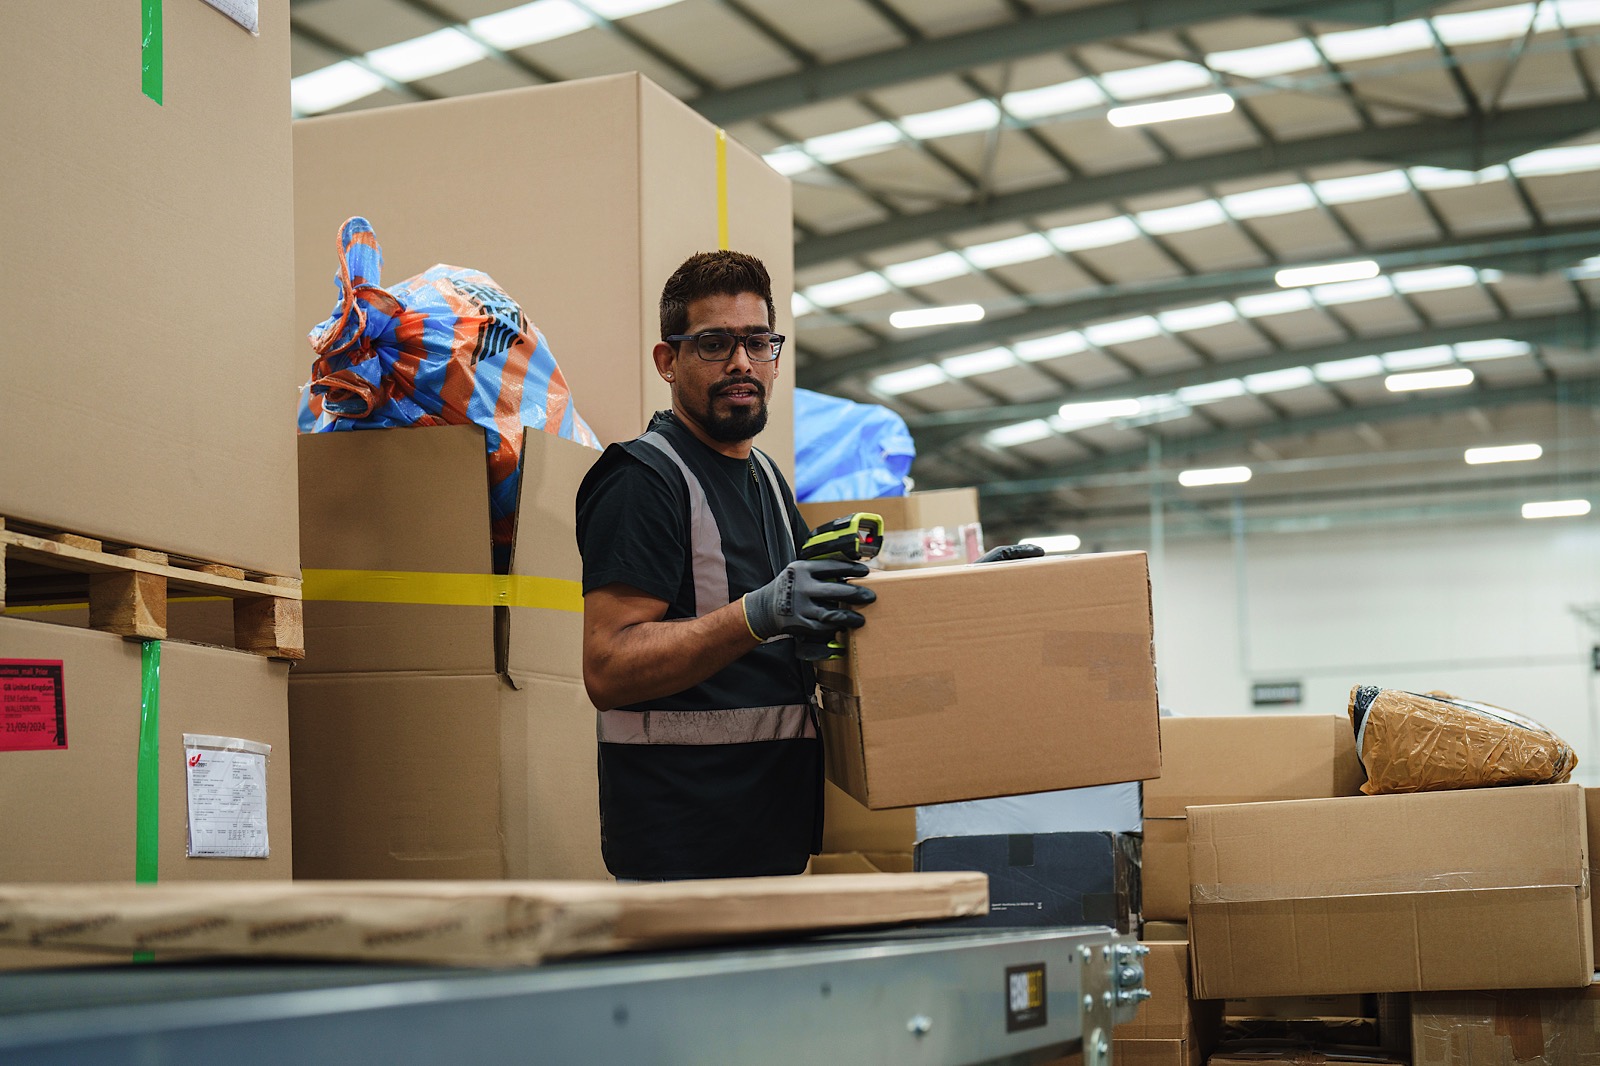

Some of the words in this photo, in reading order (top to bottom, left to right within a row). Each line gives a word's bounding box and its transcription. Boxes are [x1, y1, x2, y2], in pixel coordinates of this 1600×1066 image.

[3, 683, 11, 691] GB
[13, 683, 30, 691] United
[31, 683, 53, 692] Kingdom
[17, 694, 38, 702] Feltham
[6, 721, 46, 733] 21/09/2024
